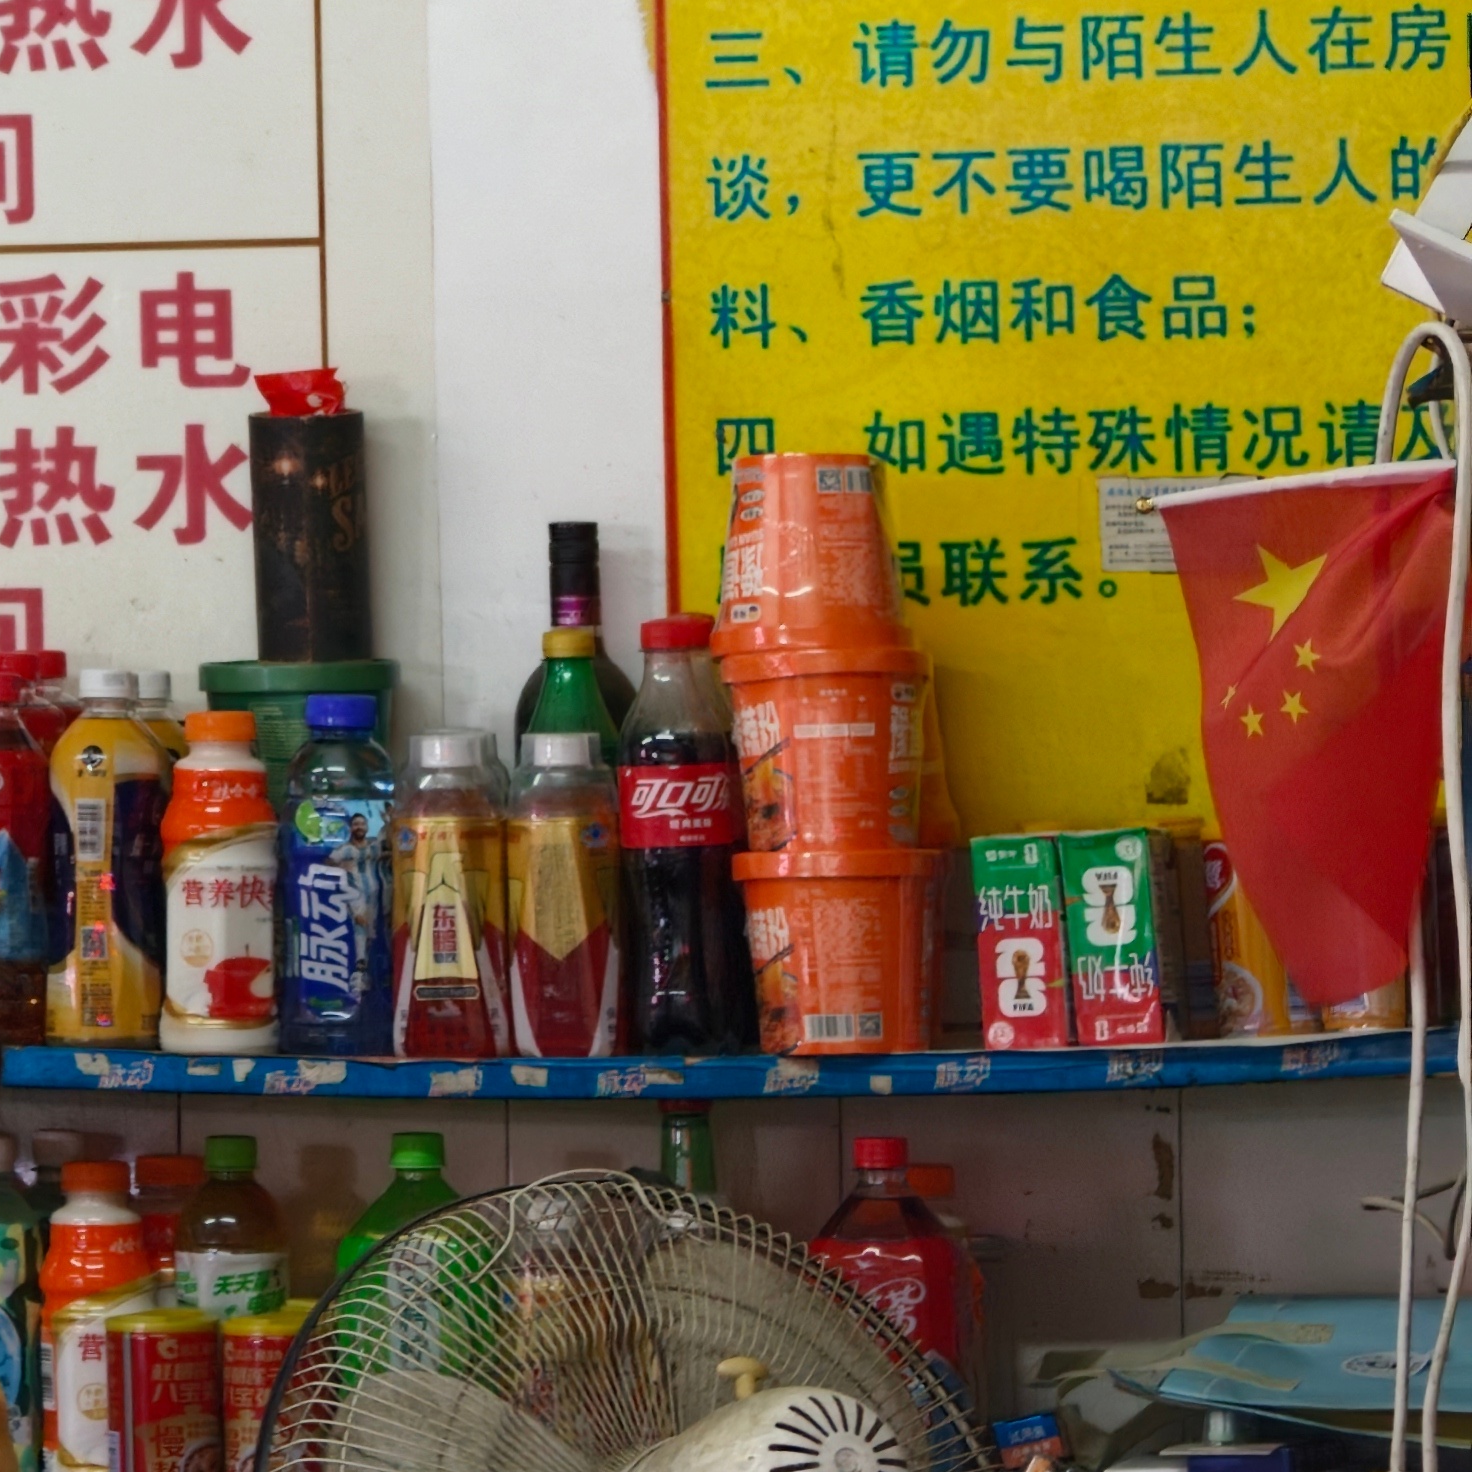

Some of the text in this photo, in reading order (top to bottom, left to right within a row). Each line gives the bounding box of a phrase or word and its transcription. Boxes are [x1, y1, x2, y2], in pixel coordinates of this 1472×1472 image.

[705, 4, 1454, 92] 三、请勿与陌生人在房
[716, 394, 1455, 478] 四如遇特殊情况请
[978, 882, 1053, 932] 纯牛奶
